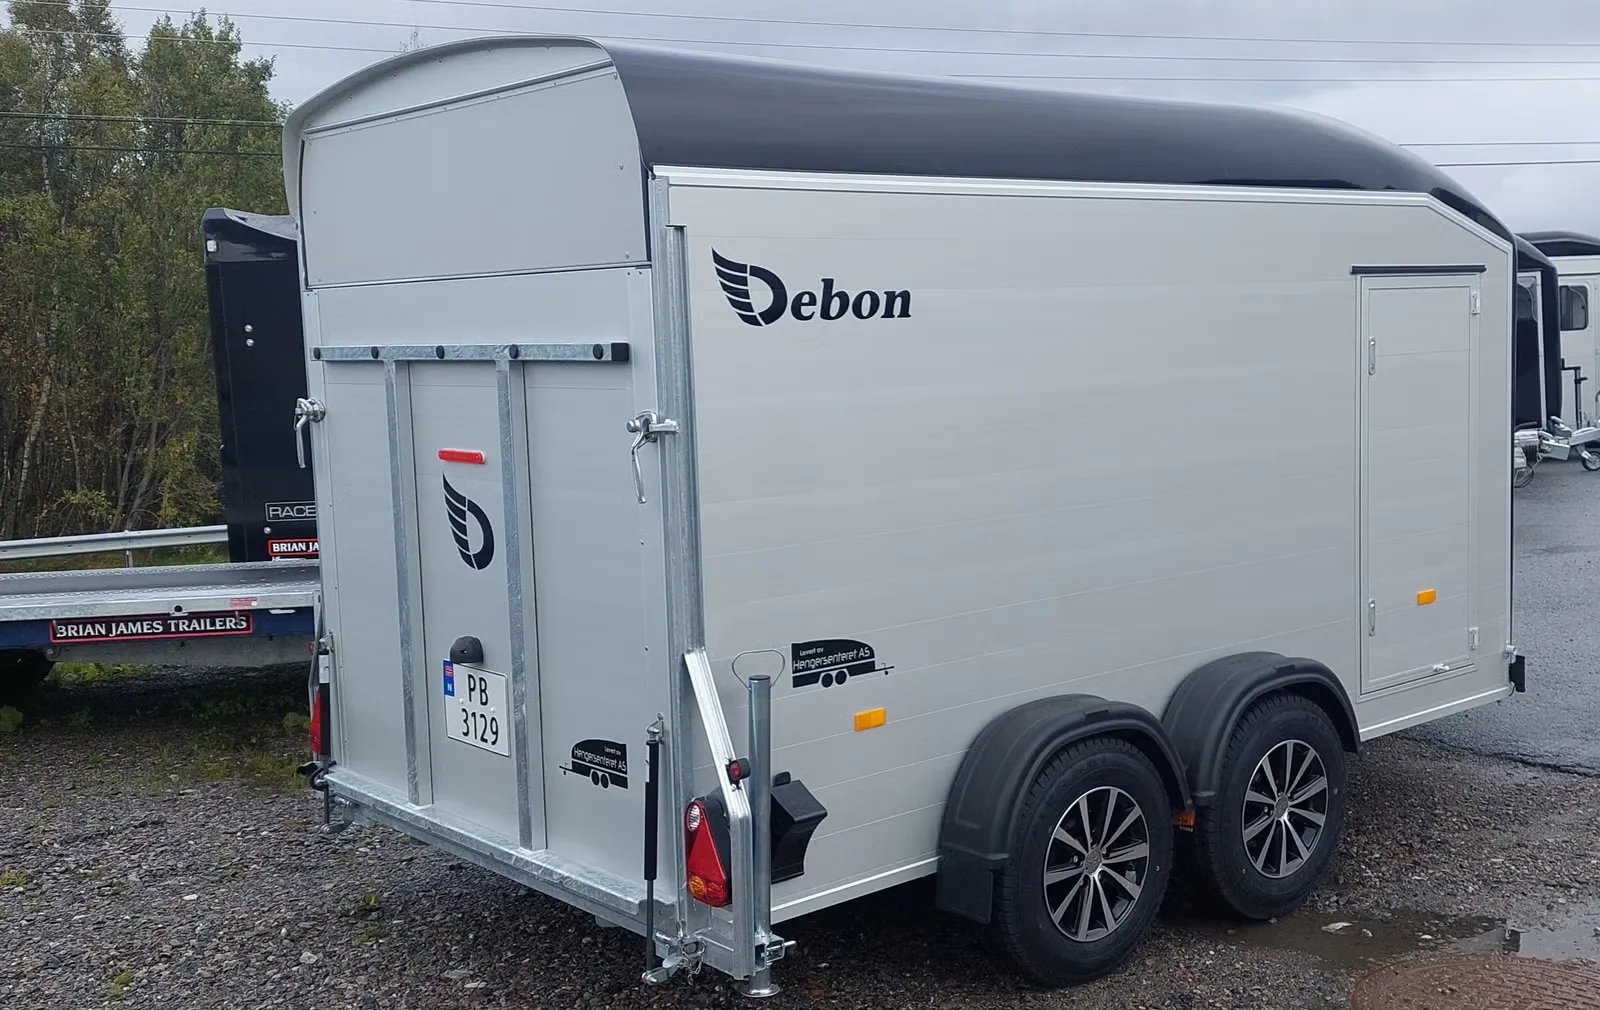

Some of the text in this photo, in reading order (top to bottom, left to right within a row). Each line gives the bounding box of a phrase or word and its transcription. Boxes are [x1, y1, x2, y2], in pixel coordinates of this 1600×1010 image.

[711, 246, 911, 327] Debon
[272, 542, 306, 553] BRIAN
[56, 616, 247, 637] BRIAN JAMES TRAILERS
[793, 646, 871, 671] Hengersenteret AS
[467, 673, 489, 706] PB
[461, 707, 499, 746] 3129
[573, 746, 627, 772] Hengersenteret AS
